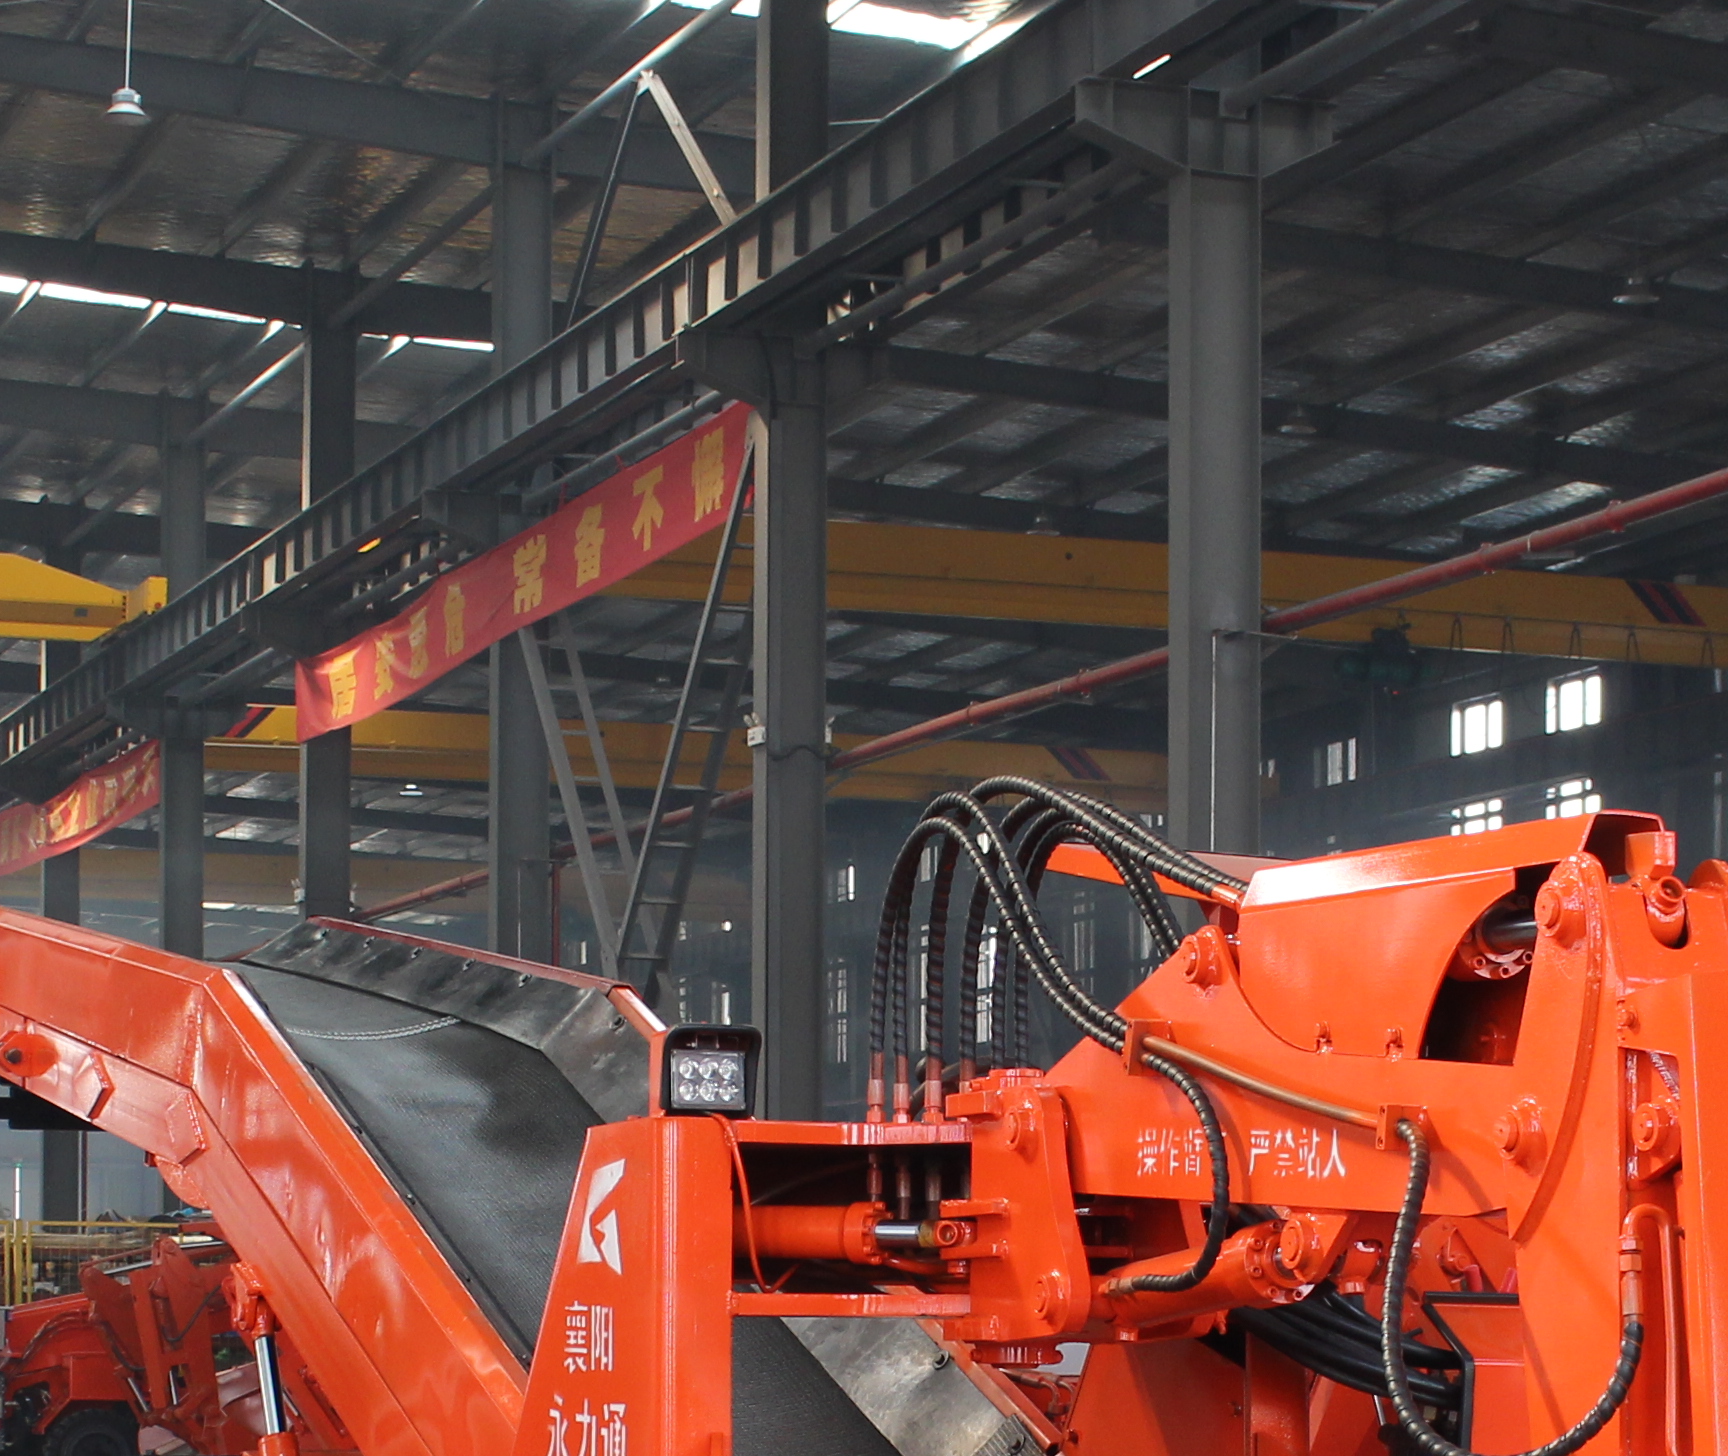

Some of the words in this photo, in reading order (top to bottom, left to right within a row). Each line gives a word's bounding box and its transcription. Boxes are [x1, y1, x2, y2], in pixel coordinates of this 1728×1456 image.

[1136, 1127, 1228, 1177] 操作臂
[1248, 1127, 1347, 1179] 严禁站人
[563, 1300, 615, 1375] 襄阳
